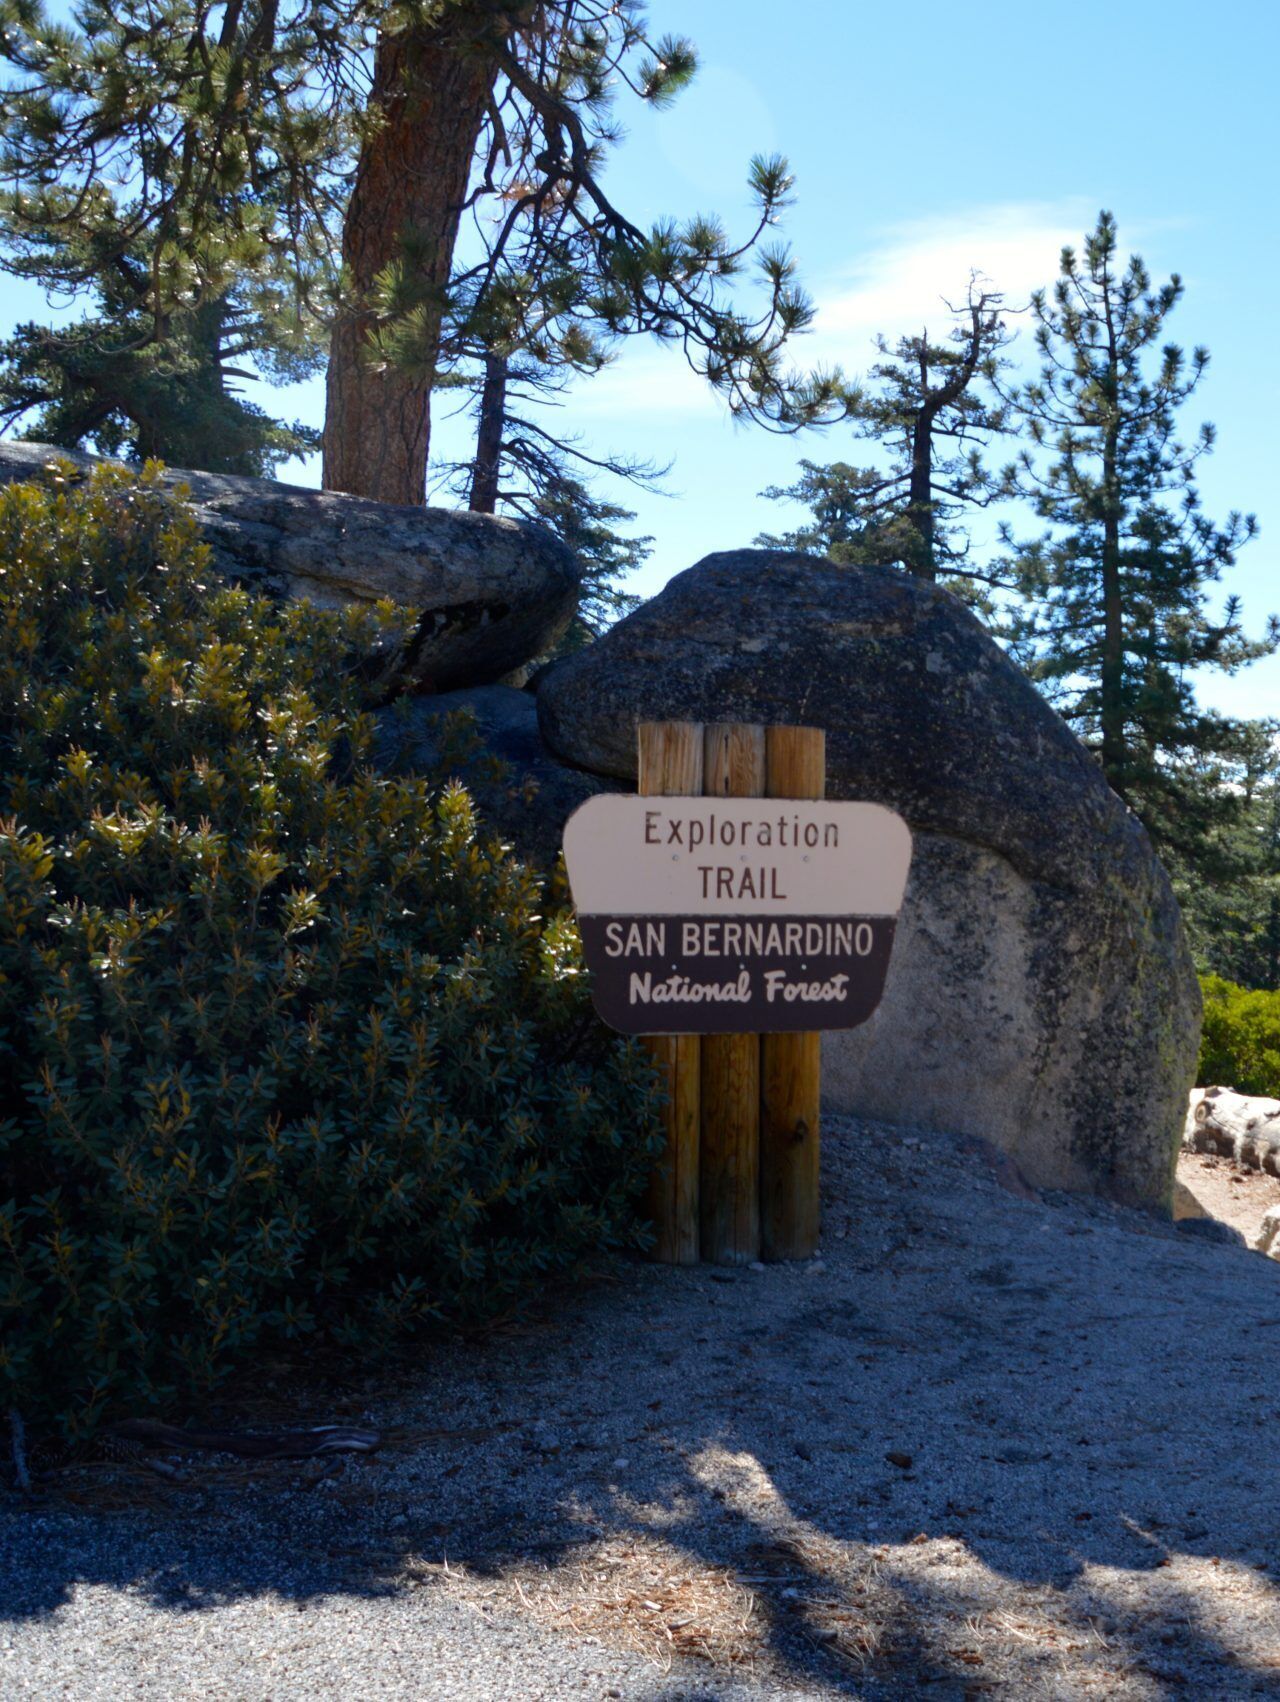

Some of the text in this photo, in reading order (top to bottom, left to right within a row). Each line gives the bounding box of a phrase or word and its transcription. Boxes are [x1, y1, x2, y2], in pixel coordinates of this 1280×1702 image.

[644, 811, 839, 853] Exploration
[698, 866, 787, 899] TRAIL
[605, 922, 873, 957] SAN BERNARDINO
[629, 970, 849, 1004] National Forest
